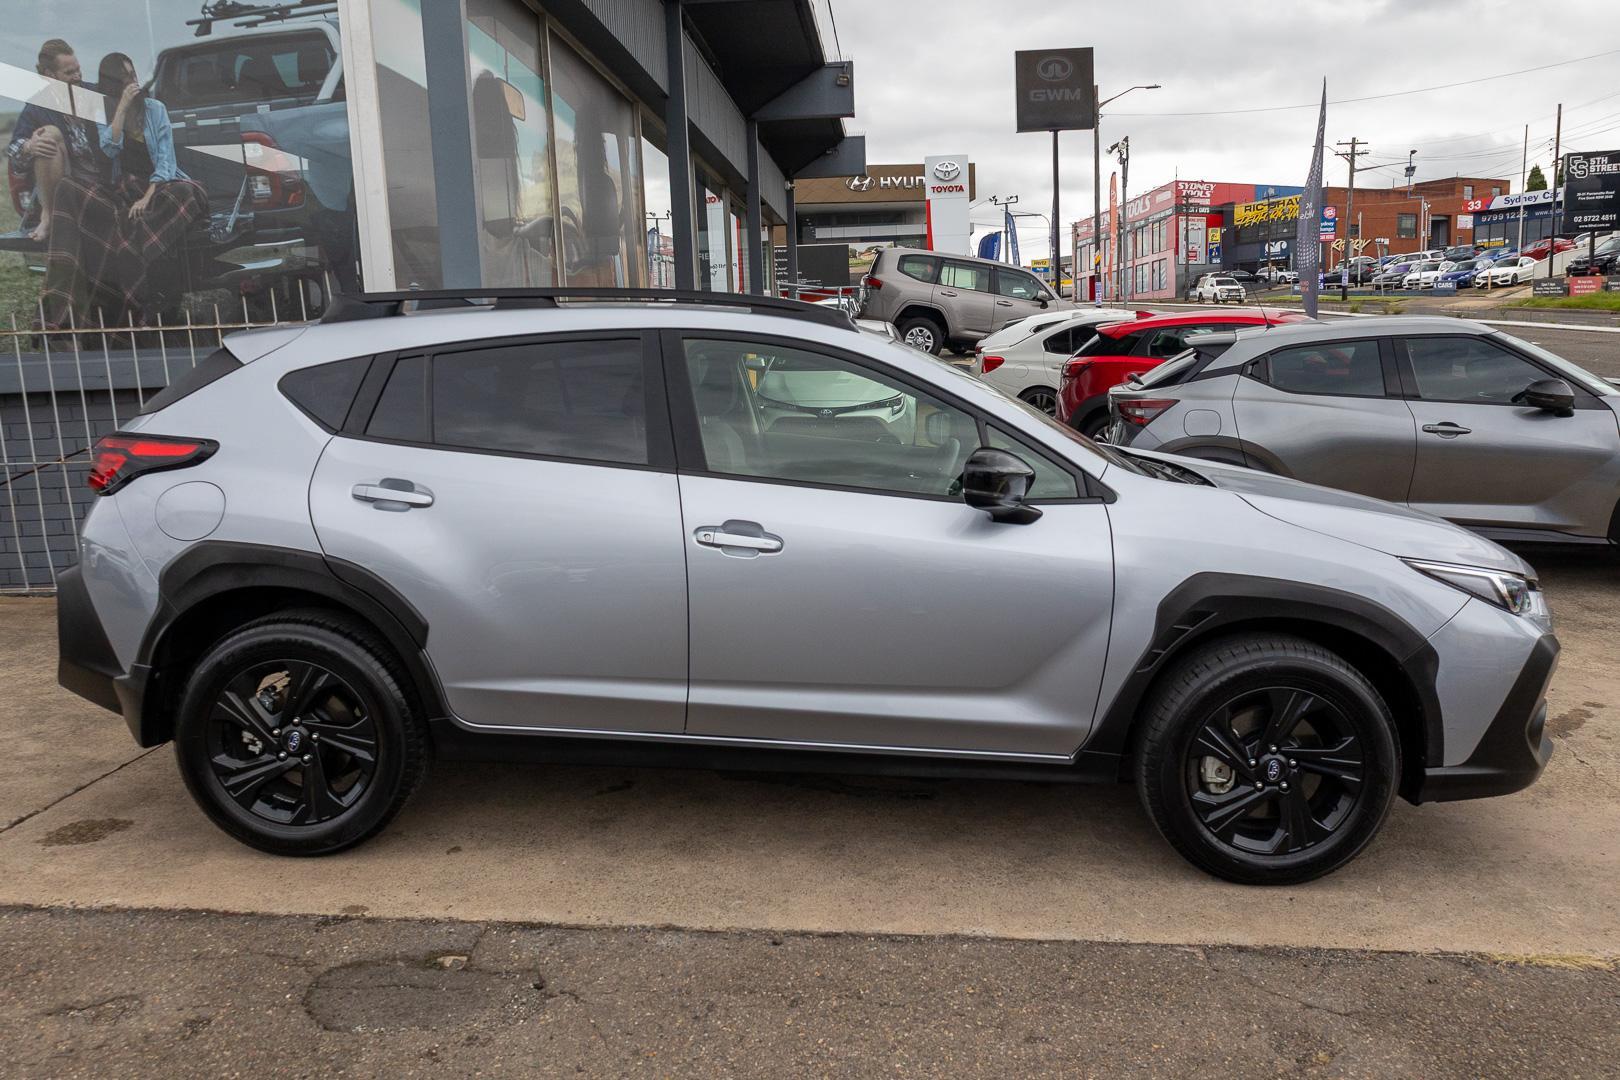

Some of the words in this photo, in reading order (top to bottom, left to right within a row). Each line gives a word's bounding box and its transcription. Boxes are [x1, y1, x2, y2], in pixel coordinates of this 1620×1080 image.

[1029, 88, 1081, 102] GWM
[931, 185, 965, 193] TOYOTA
[1177, 182, 1216, 191] SYDNEY
[1181, 190, 1212, 198] TOOLS
[1503, 194, 1540, 206] Sydney
[1542, 190, 1562, 200] Car
[1467, 200, 1482, 211] 33
[1481, 212, 1504, 222] 9799
[1574, 215, 1583, 223] 02
[1583, 214, 1600, 222] 8722
